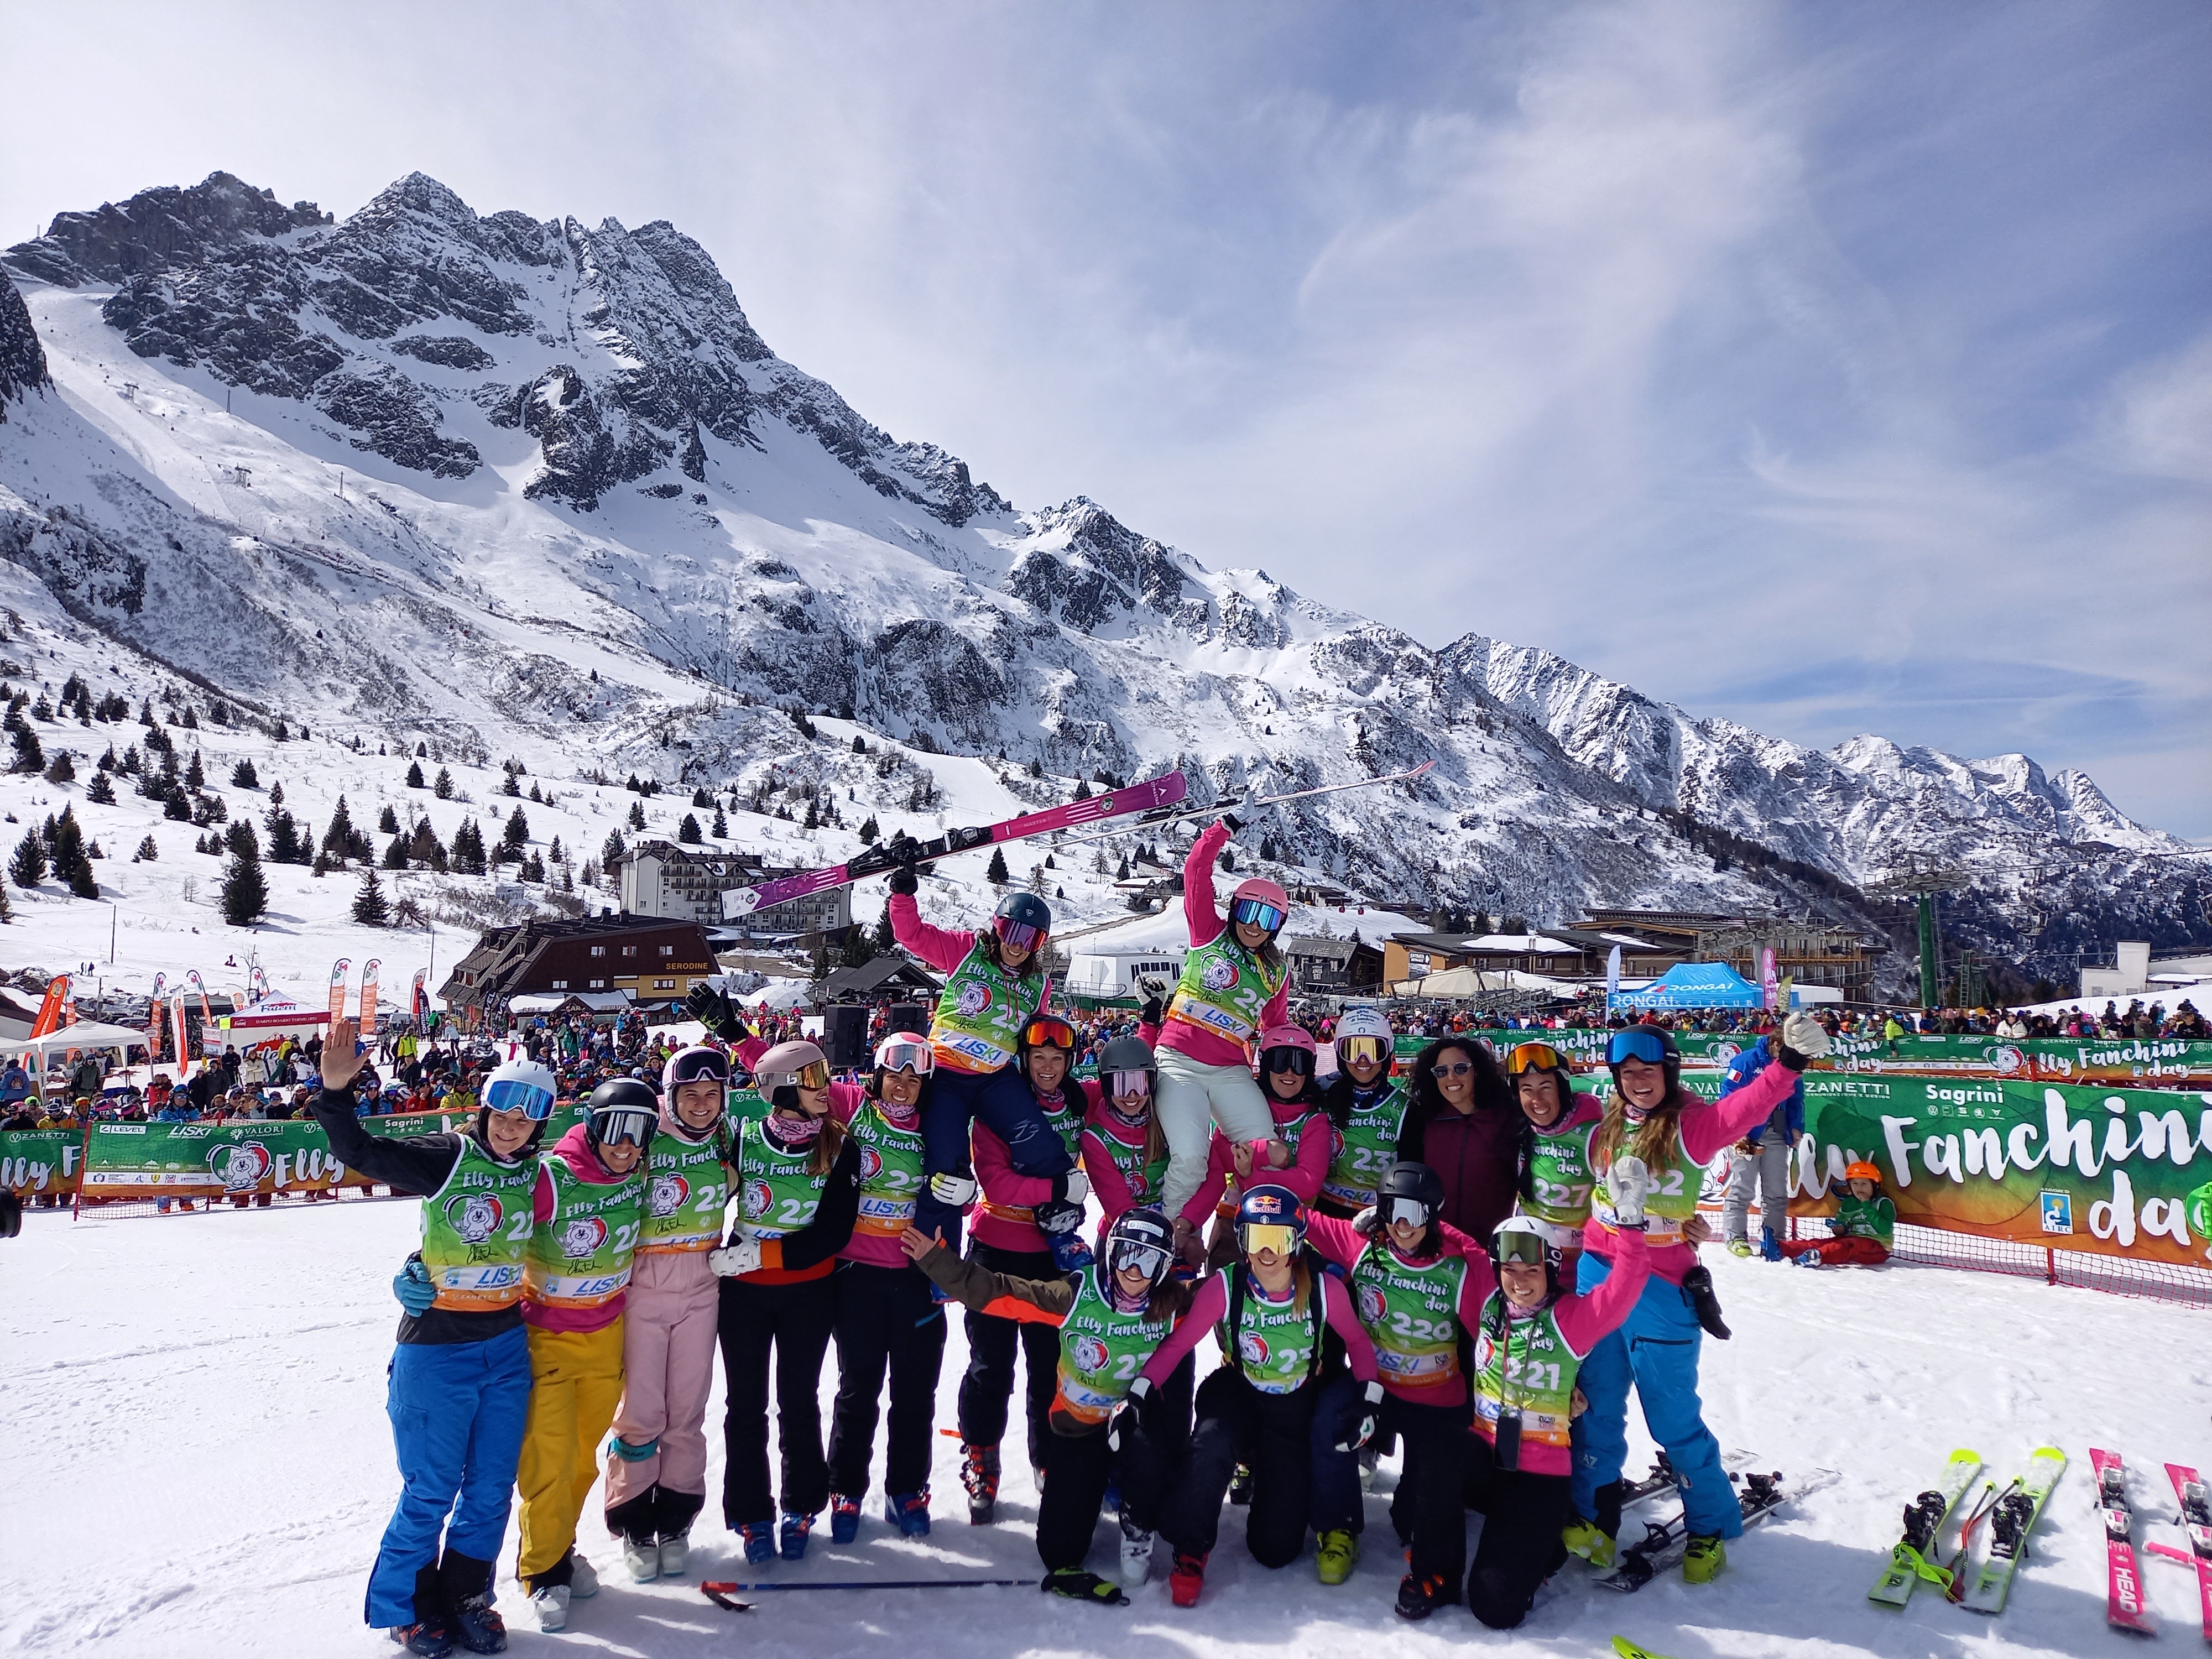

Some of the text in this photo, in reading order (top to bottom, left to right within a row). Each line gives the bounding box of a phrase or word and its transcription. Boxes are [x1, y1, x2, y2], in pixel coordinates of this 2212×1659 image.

[1150, 781, 1161, 806] DYNASTAR
[1218, 941, 1242, 959] Elly
[966, 962, 989, 979] Elly
[1668, 983, 1733, 992] RONGAI
[483, 991, 497, 1019] EVEL
[1613, 995, 1673, 1007] RONGAI
[1204, 1009, 1245, 1032] LISKI
[956, 1037, 1002, 1061] LISKI
[1585, 1047, 1606, 1064] da
[2028, 1039, 2193, 1076] lly Fanchini
[1846, 1055, 1885, 1073] day
[2147, 1059, 2193, 1079] day
[1804, 1082, 1890, 1094] ZANETTI
[1926, 1083, 2004, 1105] Sagrini
[385, 1118, 424, 1128] Sagrini
[1052, 1117, 1081, 1131] nchin
[1348, 1114, 1392, 1127] anchini
[169, 1125, 212, 1136] LISKI
[244, 1125, 284, 1135] VALORI
[854, 1124, 880, 1142] Elly
[1534, 1141, 1577, 1157] anchini
[275, 1148, 345, 1188] Elly
[649, 1152, 679, 1170] Elly
[744, 1157, 768, 1175] Elly
[769, 1161, 809, 1176] Fanch
[1115, 1154, 1133, 1169] lly
[1557, 1158, 1583, 1177] day
[462, 1170, 495, 1188] Elly
[810, 1175, 828, 1189] da
[599, 1183, 644, 1211] Fanchin
[695, 1182, 728, 1212] 23
[1535, 1177, 1592, 1208] 227
[566, 1202, 596, 1217] Elly
[778, 1198, 820, 1224] 22
[863, 1199, 911, 1214] LISKI
[1265, 1205, 1281, 1214] Bull
[2089, 1168, 2192, 1247] da
[754, 1229, 785, 1239] LIS
[2045, 1224, 2072, 1233] AIRC
[477, 1265, 523, 1285] LISKI
[576, 1270, 629, 1293] LISKI
[1387, 1272, 1449, 1296] Fanchini
[1425, 1296, 1451, 1314] day
[1076, 1316, 1104, 1334] Elly
[1107, 1319, 1166, 1337] Fanchini
[1240, 1311, 1257, 1328] lly
[1531, 1337, 1556, 1352] ay
[1505, 1358, 1560, 1391] 221
[1477, 1399, 1501, 1416] LIS
[2114, 1567, 2138, 1613] HEAD
